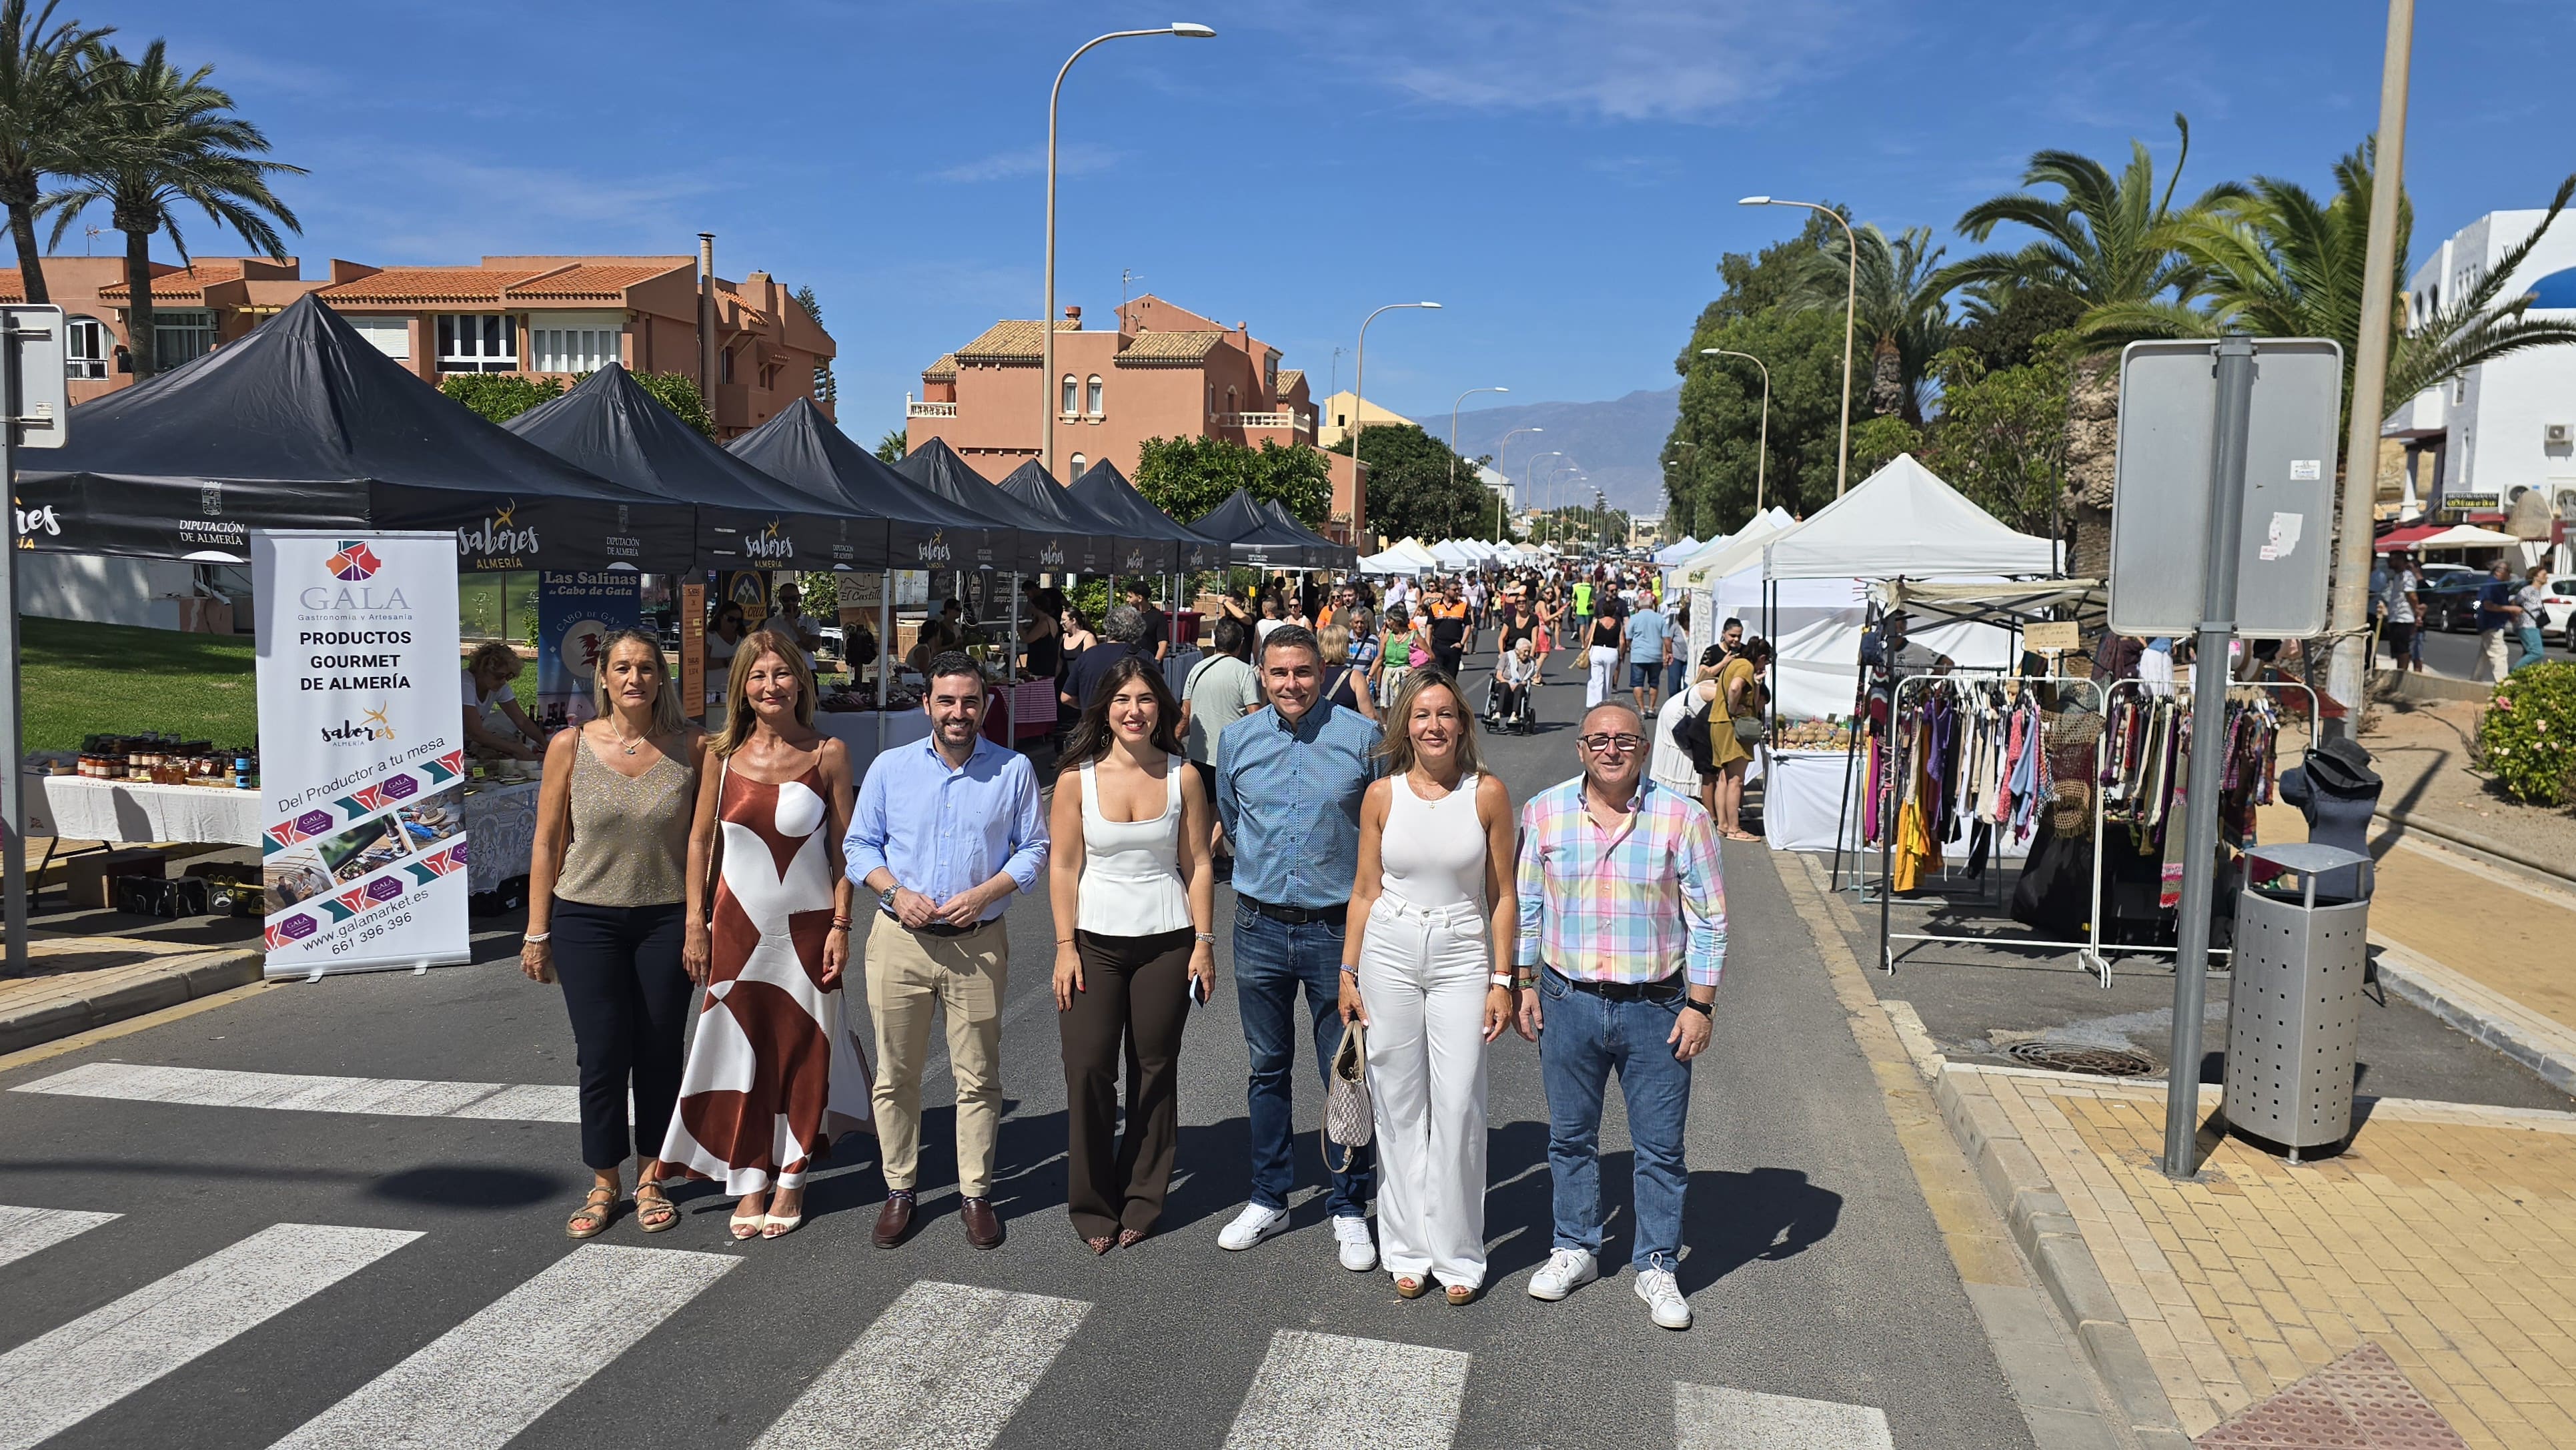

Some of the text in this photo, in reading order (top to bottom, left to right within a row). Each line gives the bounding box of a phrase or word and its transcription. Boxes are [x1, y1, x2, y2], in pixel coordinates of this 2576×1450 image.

[16, 505, 61, 536] res
[179, 520, 245, 534] DIPUTACIÓN
[16, 536, 35, 550] ÍA
[179, 532, 243, 546] DE ALMERÍA
[458, 516, 539, 556] sabores
[606, 536, 640, 547] DIPUTACIÓN
[745, 529, 793, 558] sabores
[607, 546, 639, 557] DE ALMERÍA
[476, 556, 523, 570] ALMERÍA
[754, 559, 782, 568] ALMERÍA
[544, 571, 637, 585] Las Salinas
[558, 586, 586, 596] Cabo
[589, 586, 603, 596] de
[606, 587, 632, 596] Gata
[840, 590, 851, 601] El
[299, 587, 412, 610] GALA
[556, 610, 582, 632] CABO
[300, 631, 412, 645] PRODUCTOS
[310, 654, 401, 668] GOURMET
[301, 674, 412, 690] DE ALMERÍA
[321, 720, 398, 742] sabores
[278, 794, 303, 812] Del
[306, 766, 374, 802] Productor
[378, 761, 387, 772] a
[390, 753, 404, 766] tu
[407, 738, 446, 760] mesa
[388, 777, 410, 789] GALA
[303, 813, 324, 825] GALA
[373, 878, 394, 891] GALA
[287, 916, 308, 929] GALA
[303, 890, 429, 952] www.galamarket.es
[332, 912, 412, 955] 661 396 396
